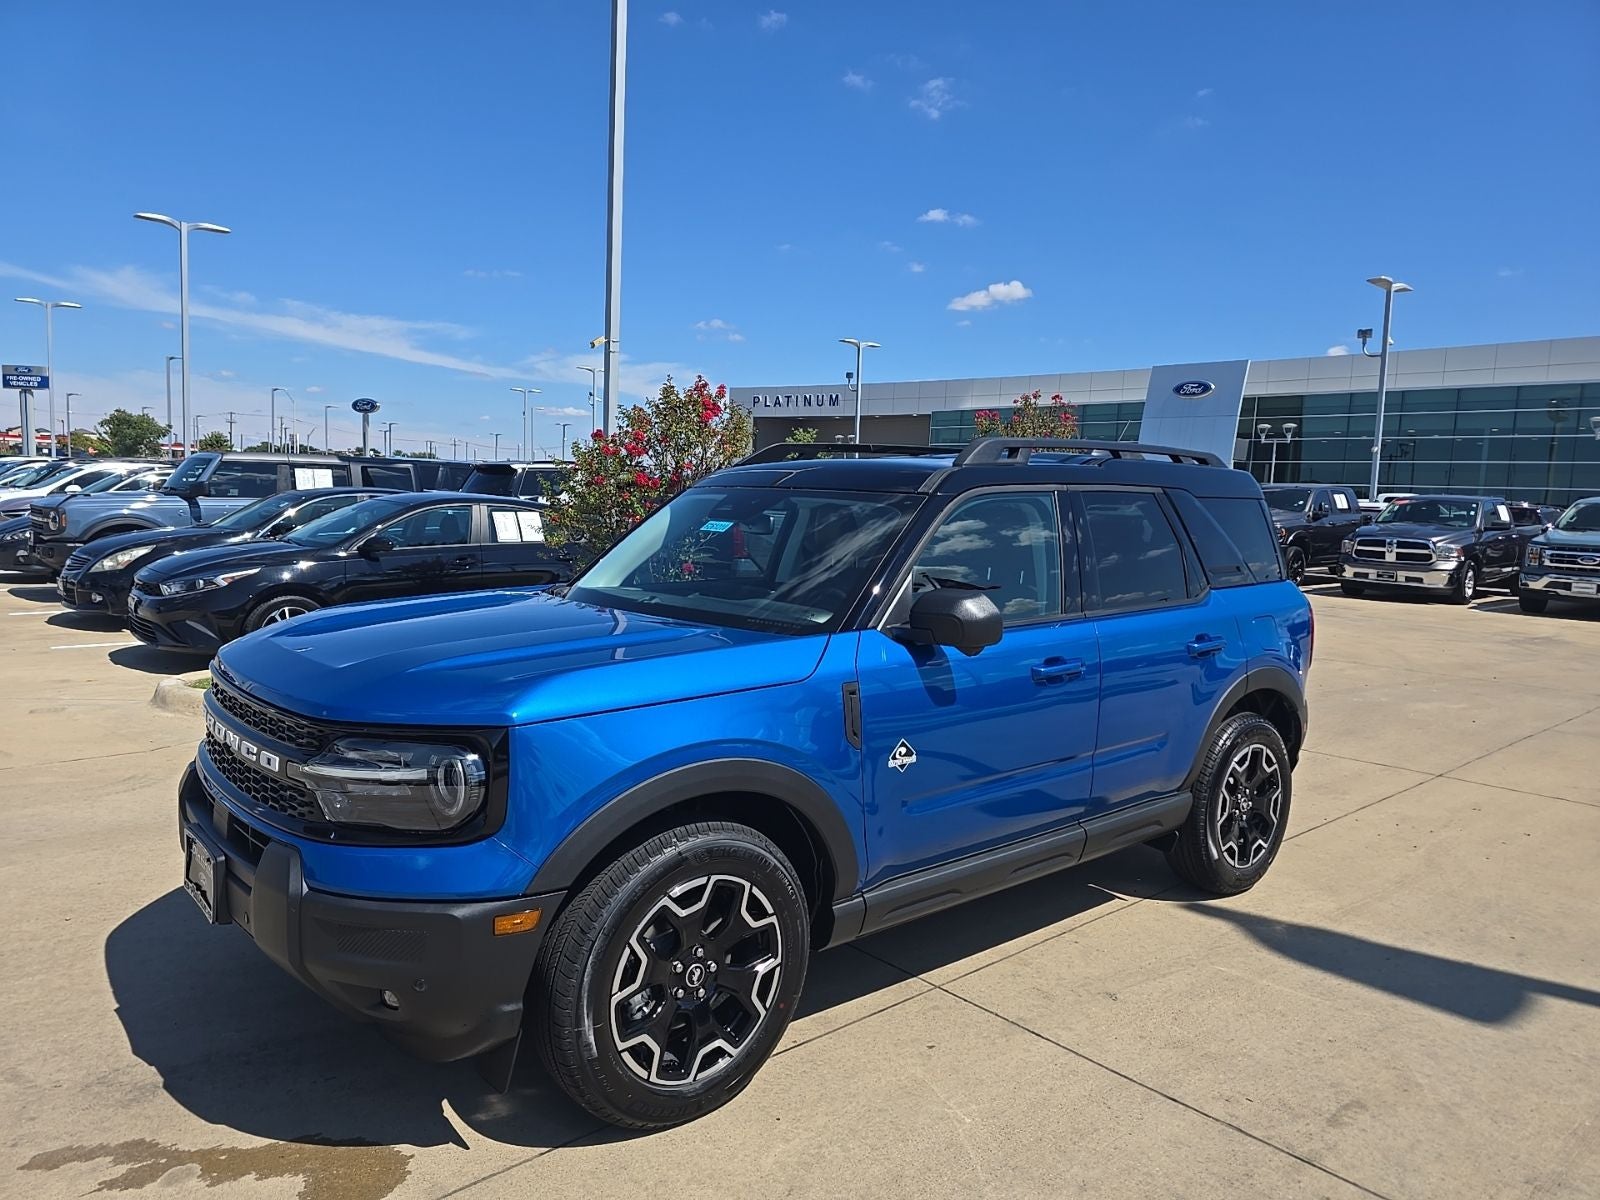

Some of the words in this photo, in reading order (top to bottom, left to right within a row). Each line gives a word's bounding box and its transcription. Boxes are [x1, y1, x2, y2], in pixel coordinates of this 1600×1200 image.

[1180, 383, 1204, 394] Ford
[753, 393, 840, 408] PLATINUM
[202, 703, 279, 773] RONCO
